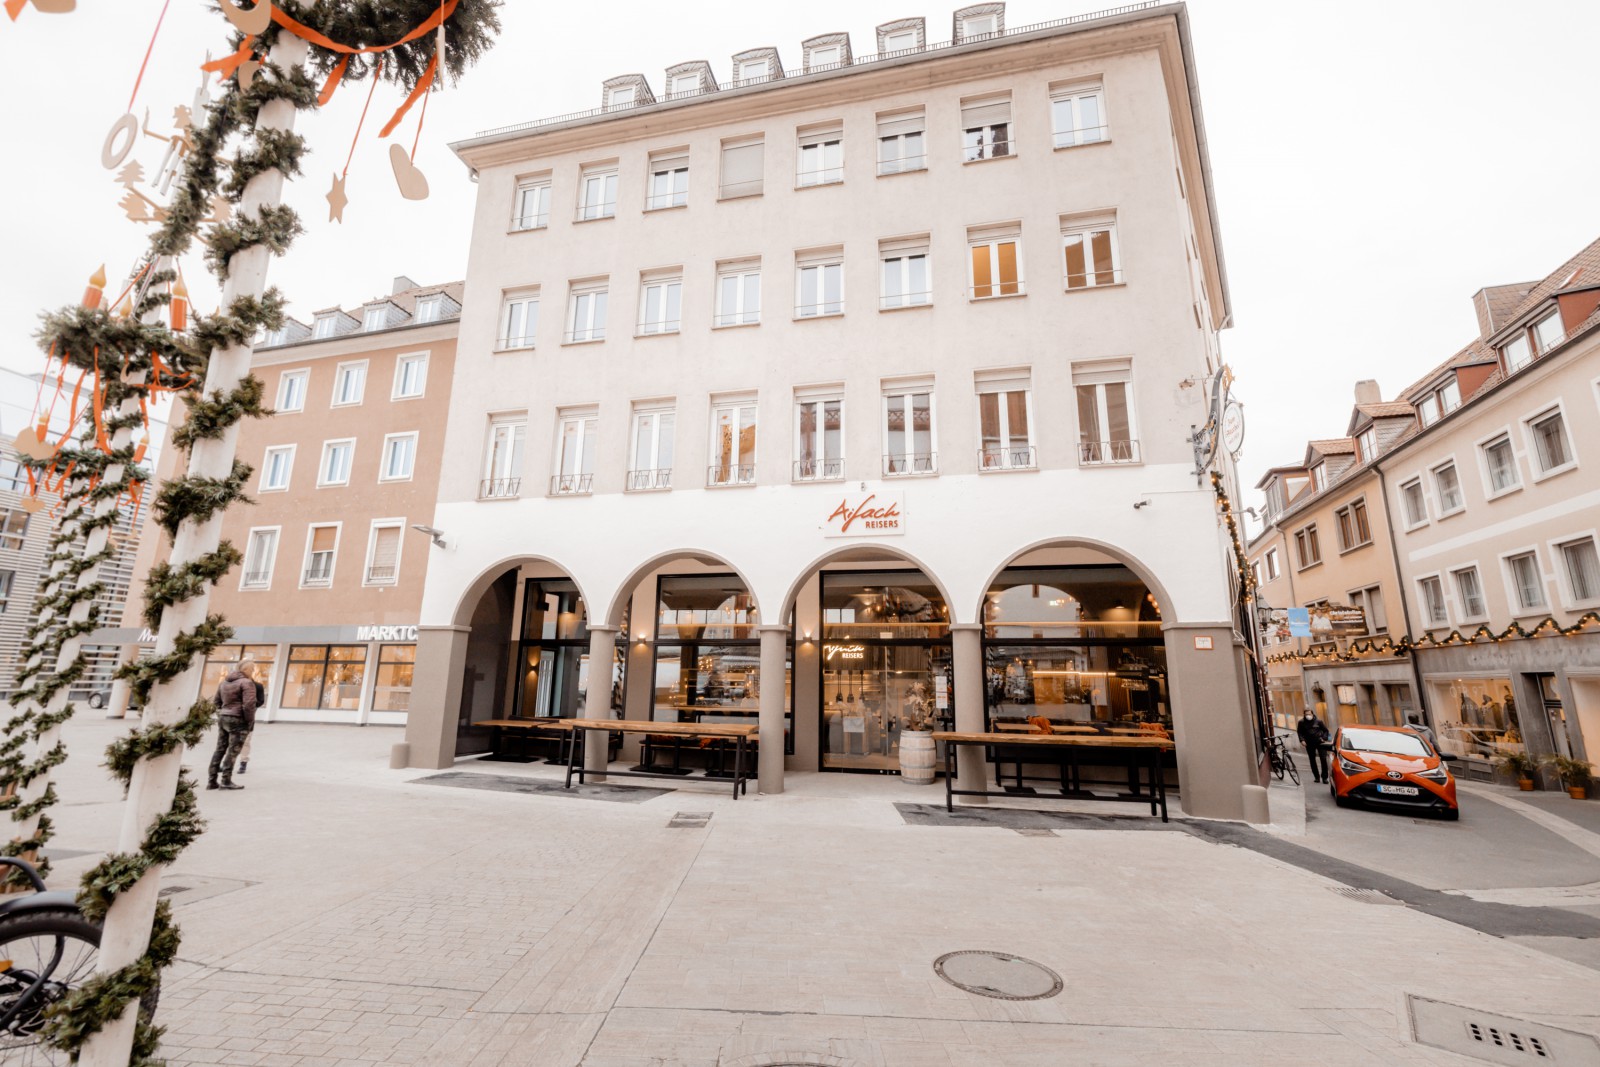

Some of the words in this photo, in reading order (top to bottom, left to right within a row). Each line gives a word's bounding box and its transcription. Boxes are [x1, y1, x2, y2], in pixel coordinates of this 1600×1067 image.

[827, 494, 900, 533] Aifach
[865, 520, 898, 529] REISERS
[356, 625, 418, 641] MARKTC
